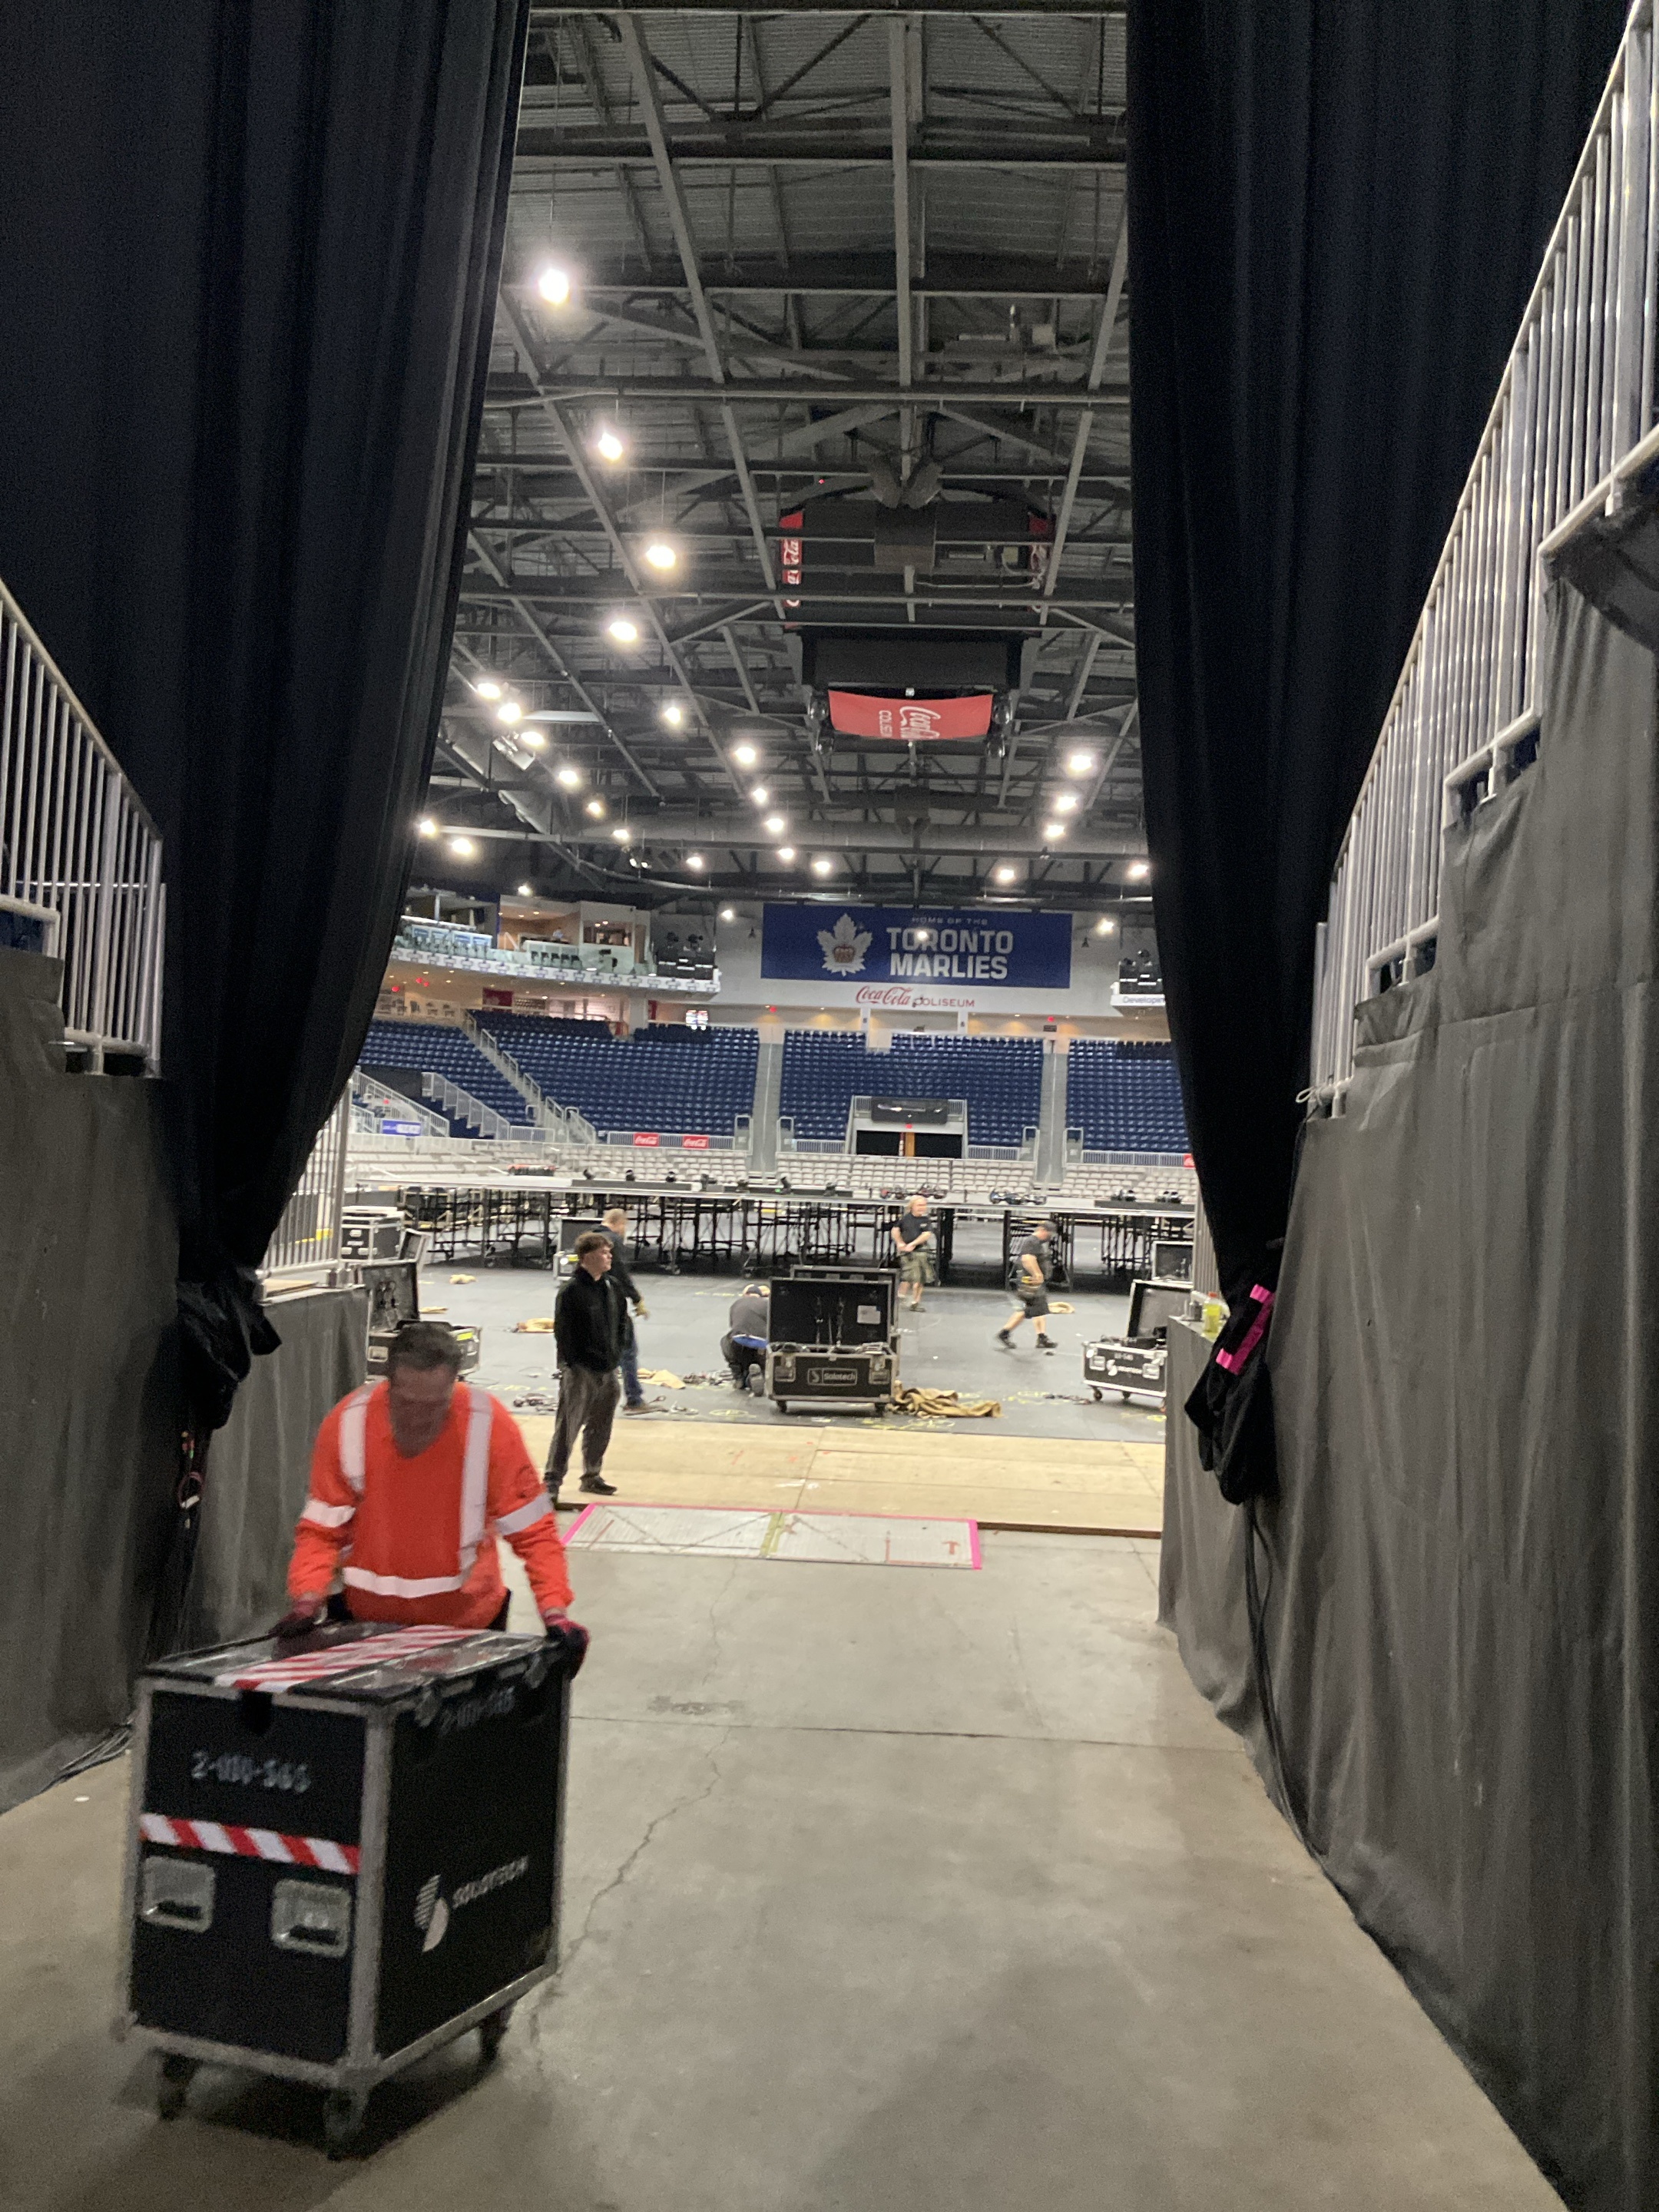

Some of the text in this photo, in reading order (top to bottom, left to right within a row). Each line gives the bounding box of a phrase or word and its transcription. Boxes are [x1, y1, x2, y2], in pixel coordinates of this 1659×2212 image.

[886, 927, 1014, 954] TORONTO
[889, 952, 1008, 979] MARLIES
[856, 985, 913, 1005] Coca-Cola
